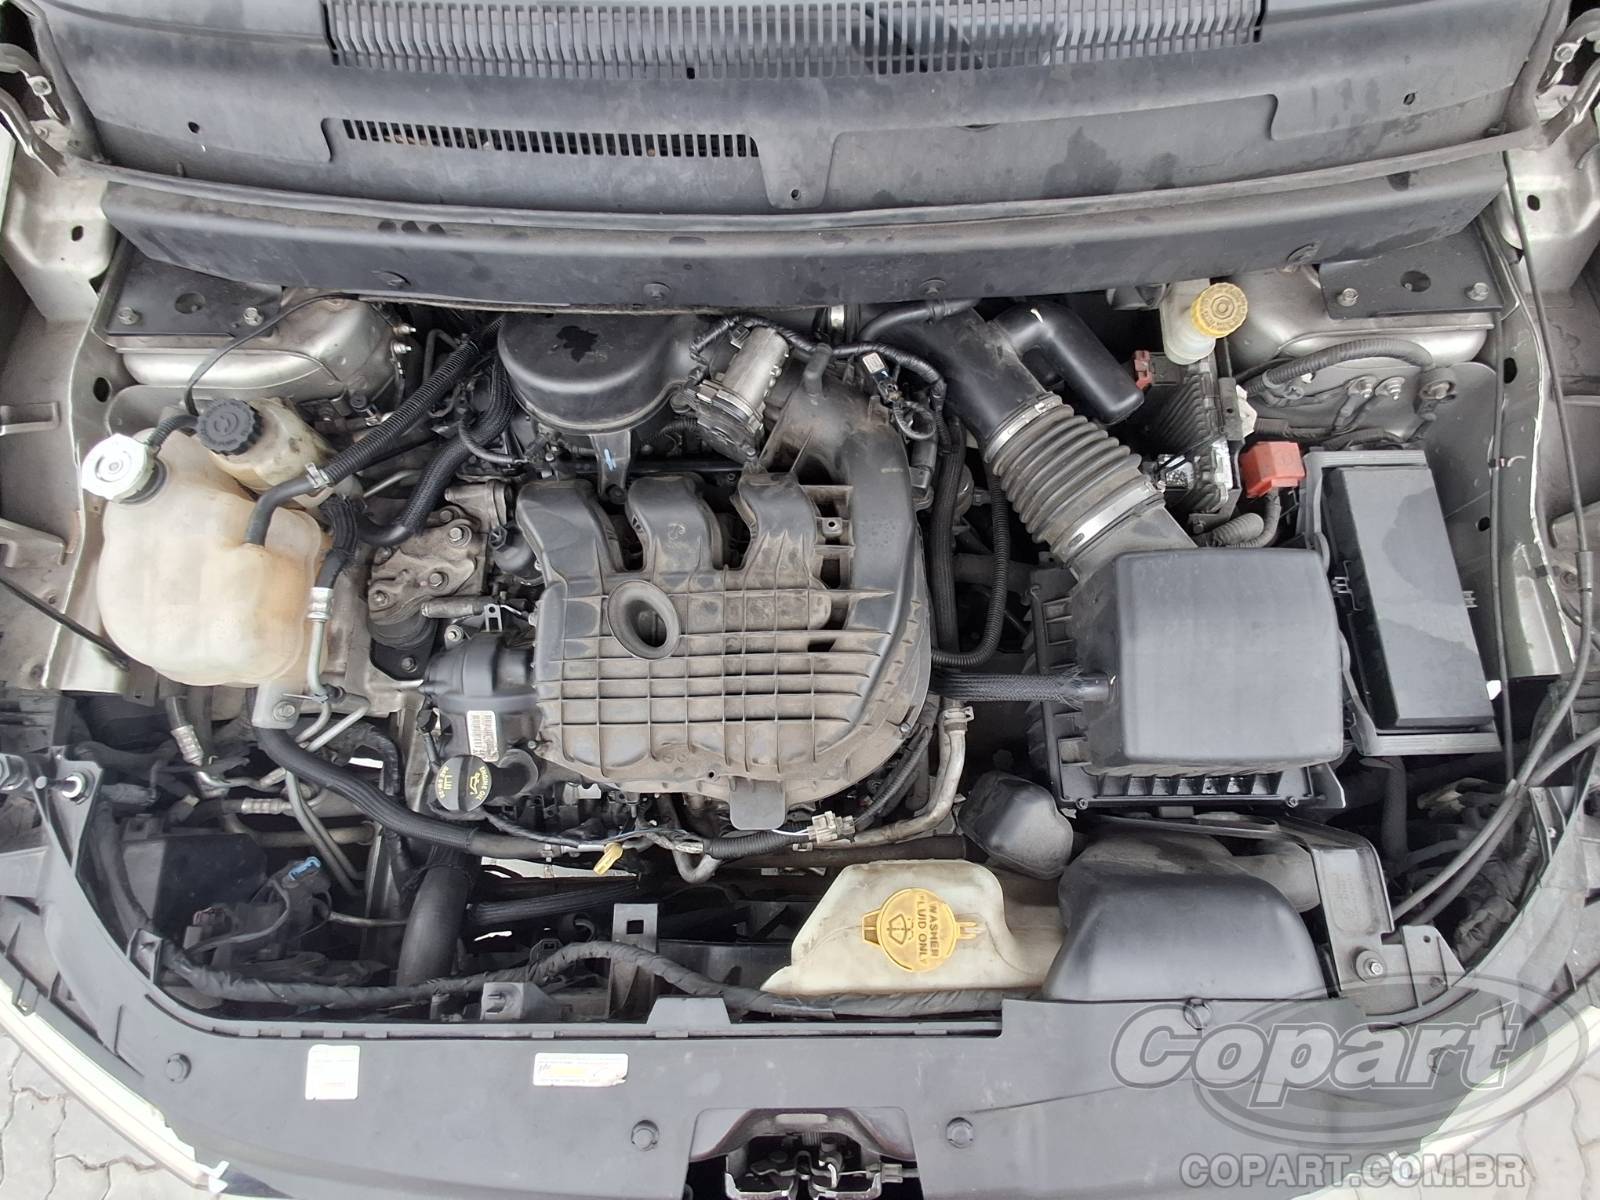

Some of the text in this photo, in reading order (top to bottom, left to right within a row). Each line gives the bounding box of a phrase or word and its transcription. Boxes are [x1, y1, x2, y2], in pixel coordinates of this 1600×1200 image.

[475, 765, 489, 801] ENGINE OIL
[929, 904, 939, 957] WASHER
